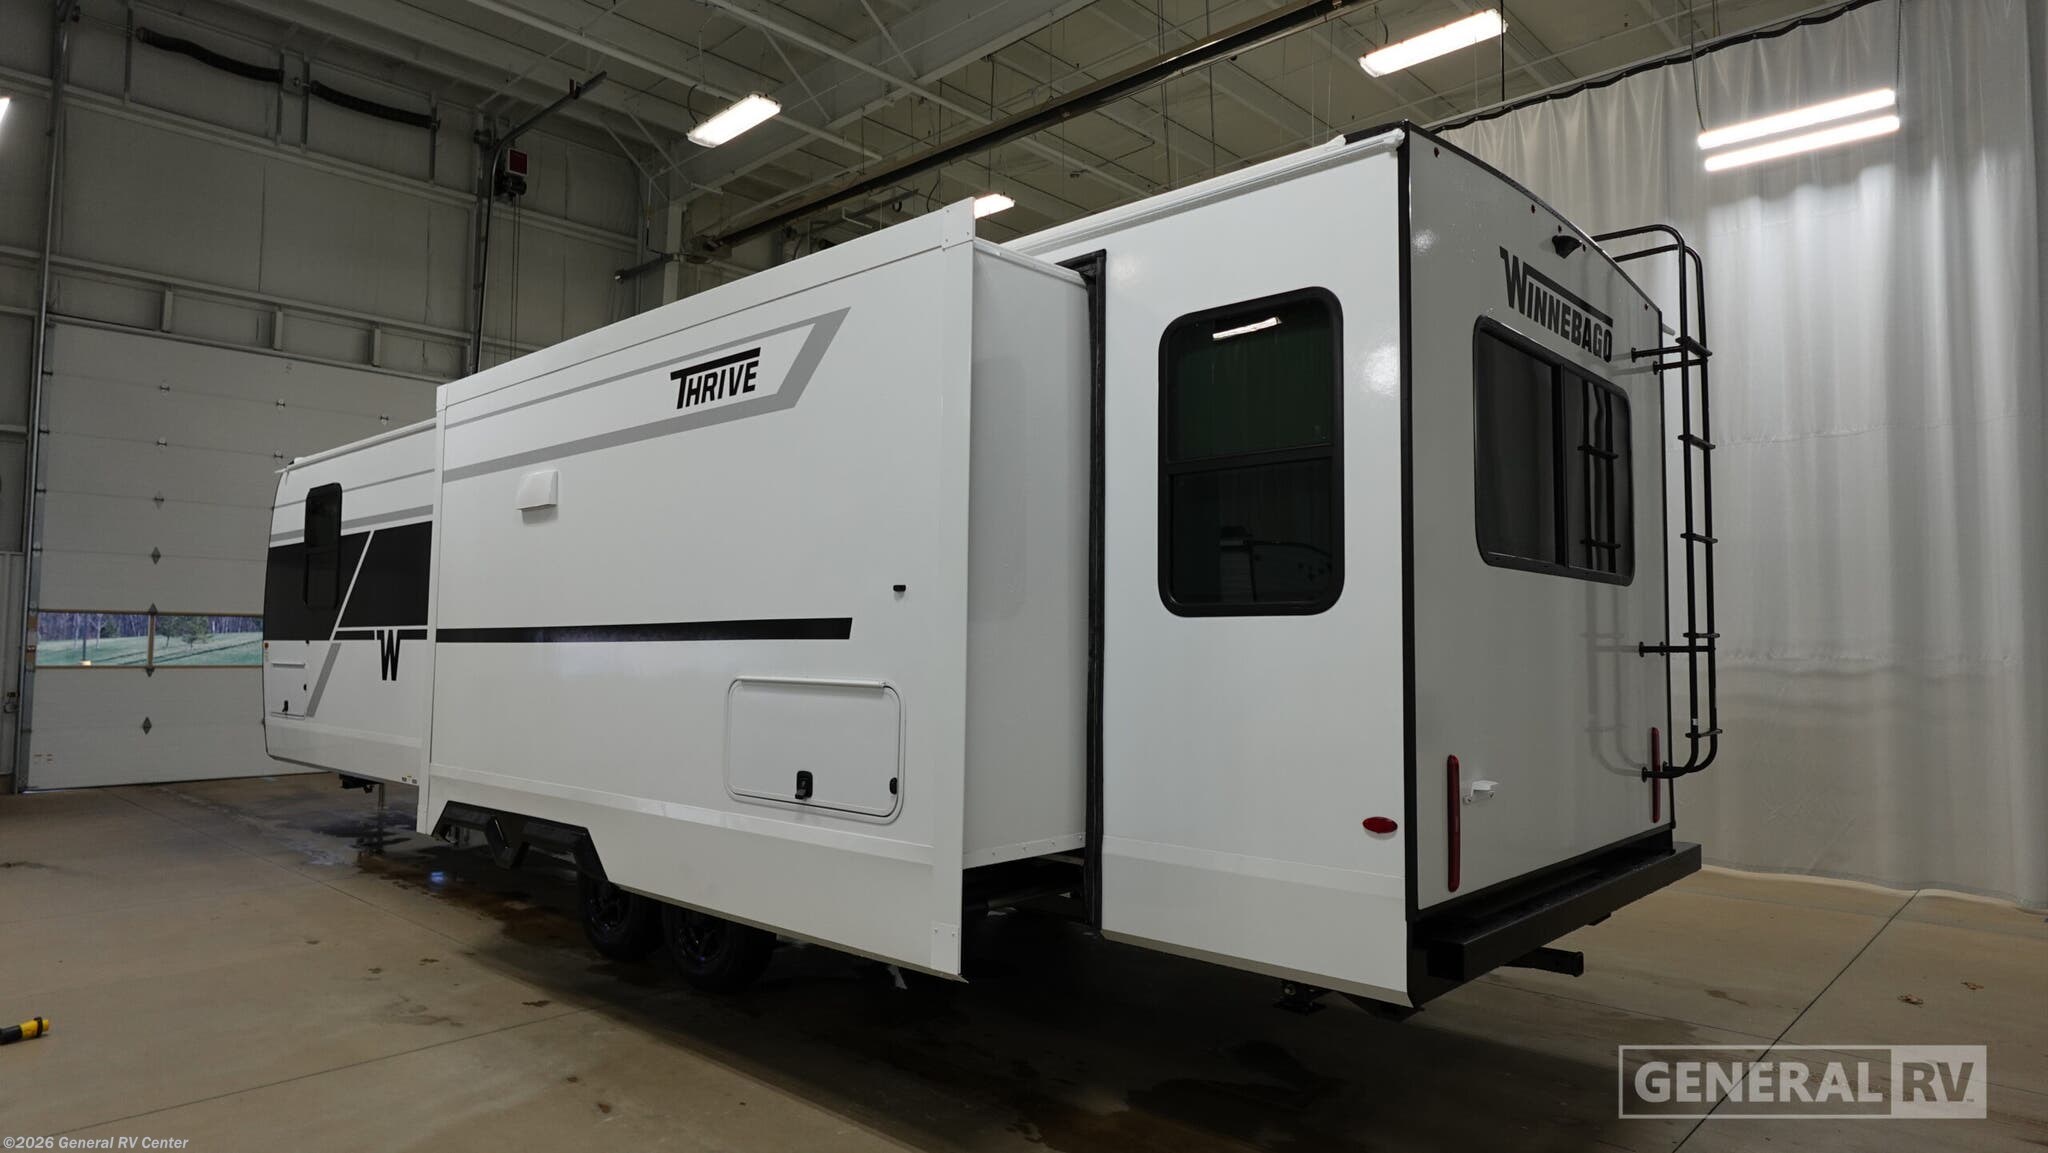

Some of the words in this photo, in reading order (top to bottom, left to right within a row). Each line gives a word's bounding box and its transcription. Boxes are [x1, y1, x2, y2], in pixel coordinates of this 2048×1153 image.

[1499, 245, 1614, 363] WINNEBAGO
[670, 346, 762, 410] THRIVE
[376, 629, 402, 682] W
